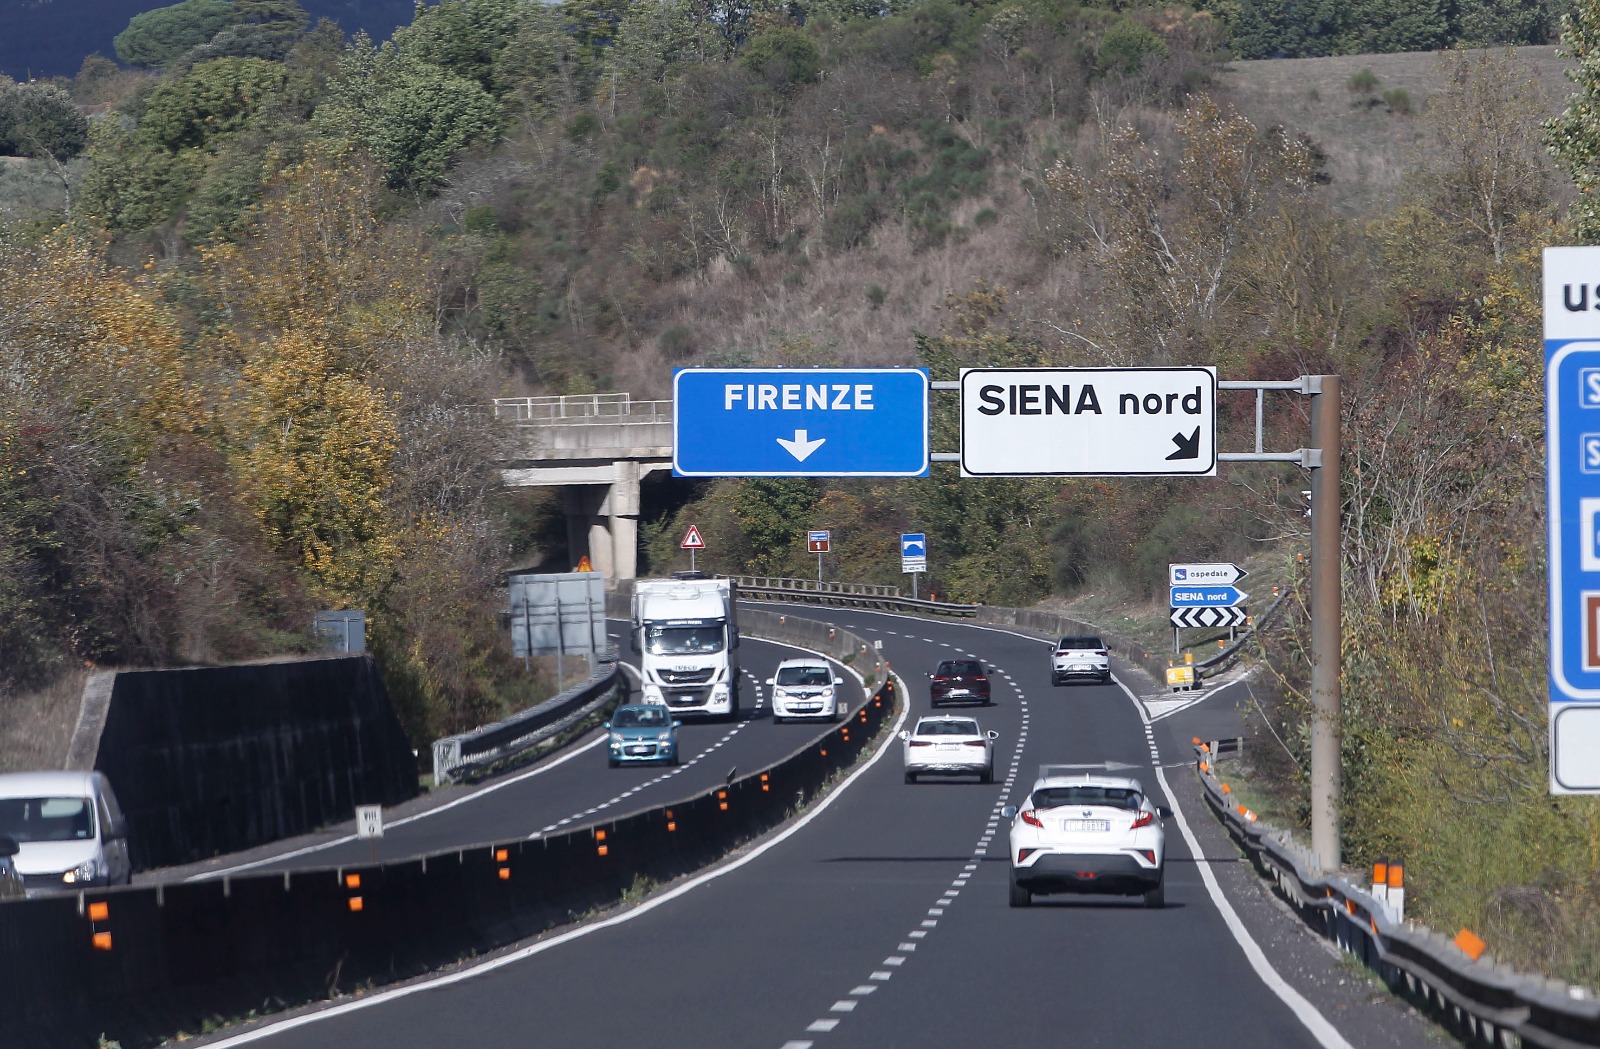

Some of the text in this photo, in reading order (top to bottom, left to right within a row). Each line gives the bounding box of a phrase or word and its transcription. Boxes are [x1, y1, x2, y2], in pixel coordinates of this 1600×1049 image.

[724, 384, 875, 410] FIRENZE
[977, 384, 1203, 416] SIENA nord
[815, 541, 821, 550] 1
[1190, 570, 1228, 578] ospedale
[1174, 592, 1228, 602] SIENA nord
